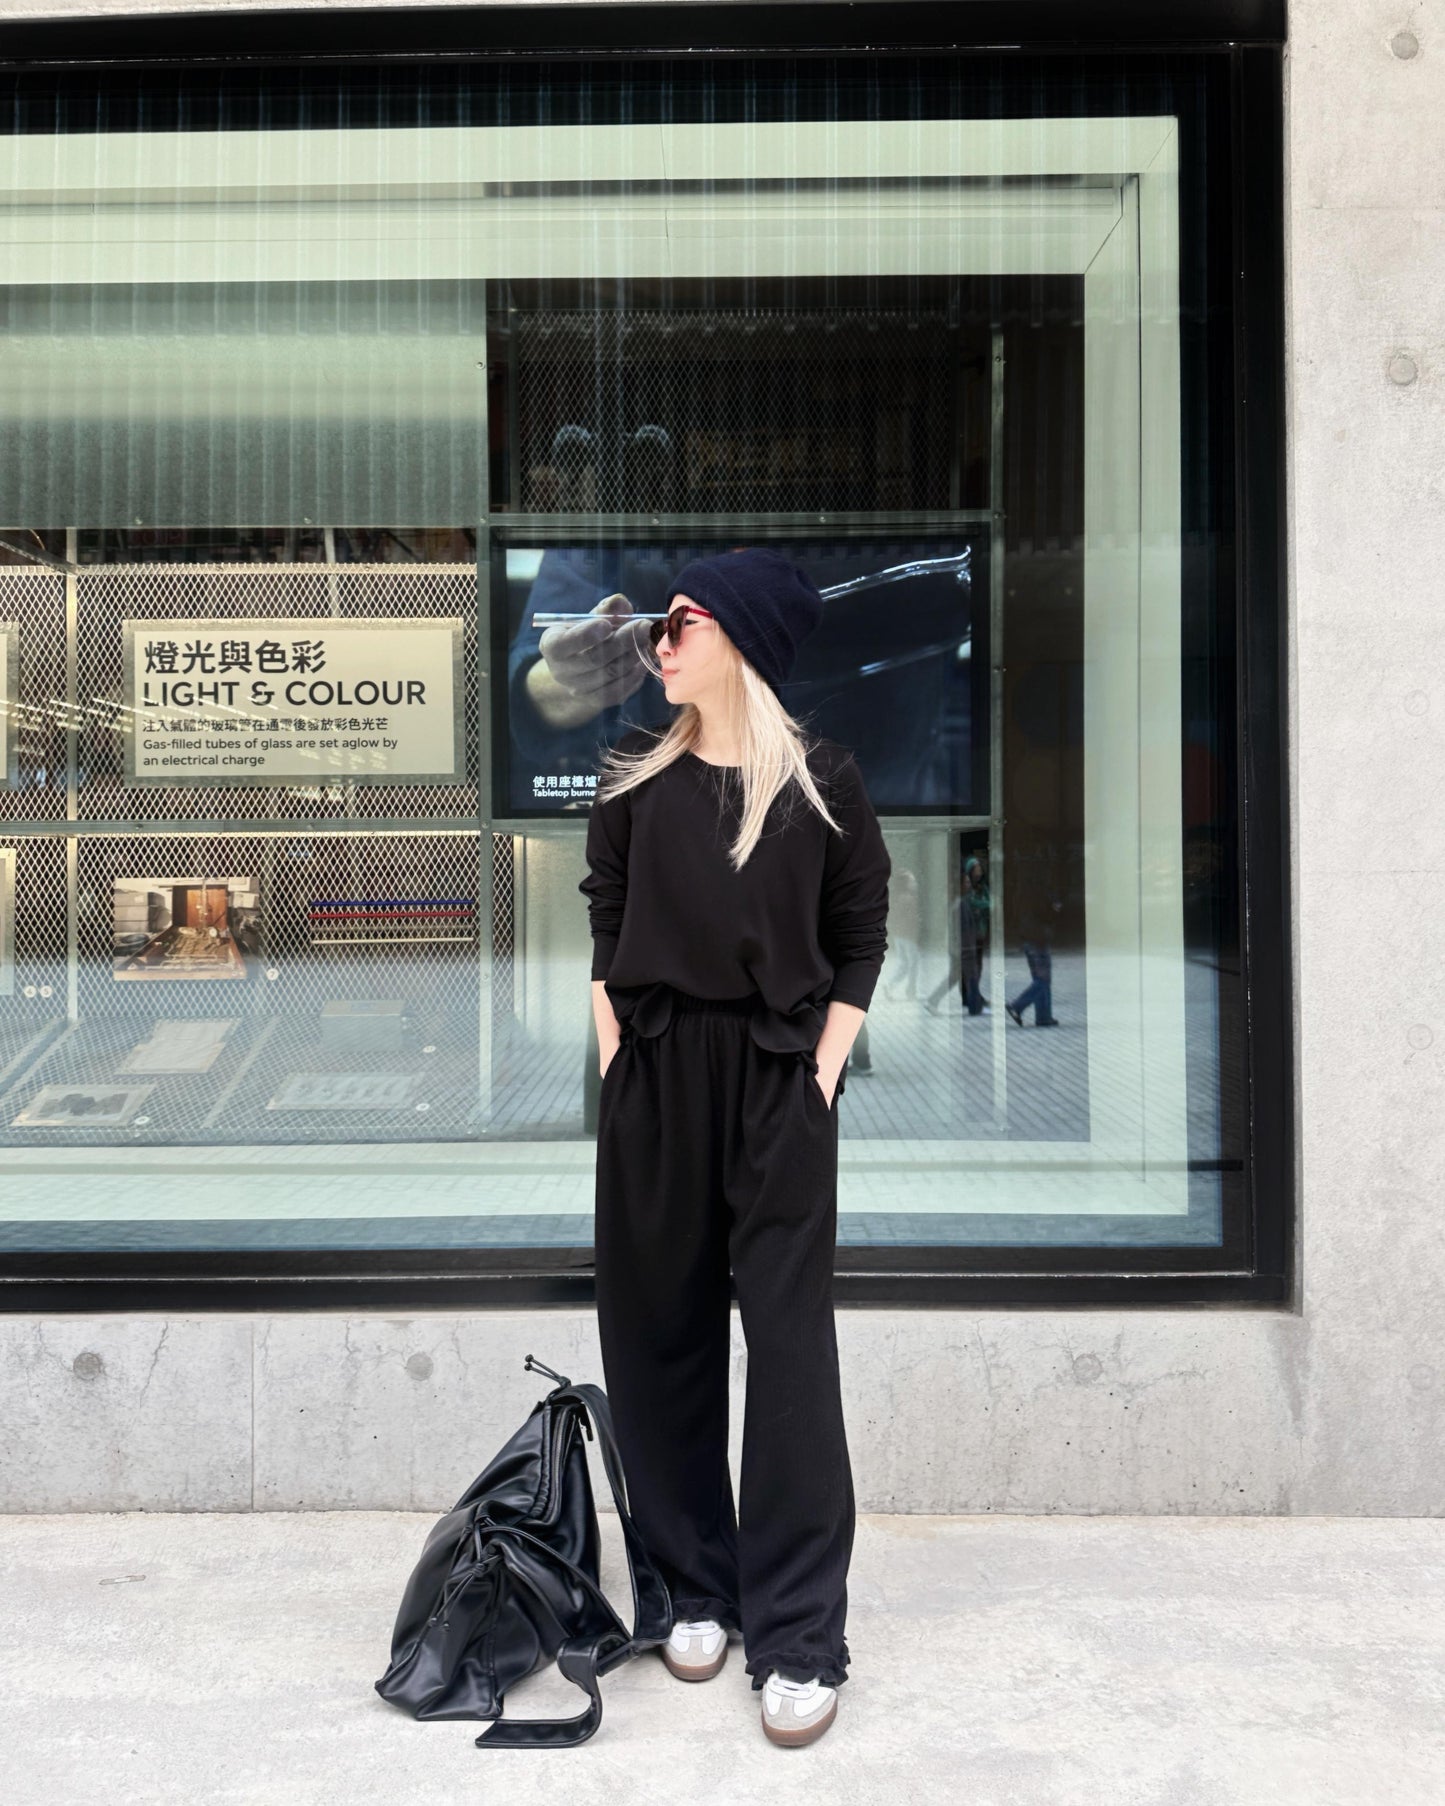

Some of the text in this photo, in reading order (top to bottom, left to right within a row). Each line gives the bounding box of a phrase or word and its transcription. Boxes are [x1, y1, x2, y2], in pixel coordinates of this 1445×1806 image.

[144, 640, 326, 674] 燈光與色彩
[143, 680, 426, 706] LIGHT & COLOUR
[143, 738, 397, 751] Gas-filled tubes of glass are set aglow by
[143, 755, 265, 767] an electrical charge
[533, 776, 601, 788] 使用座檯爐
[533, 789, 597, 798] Tabletop burne
